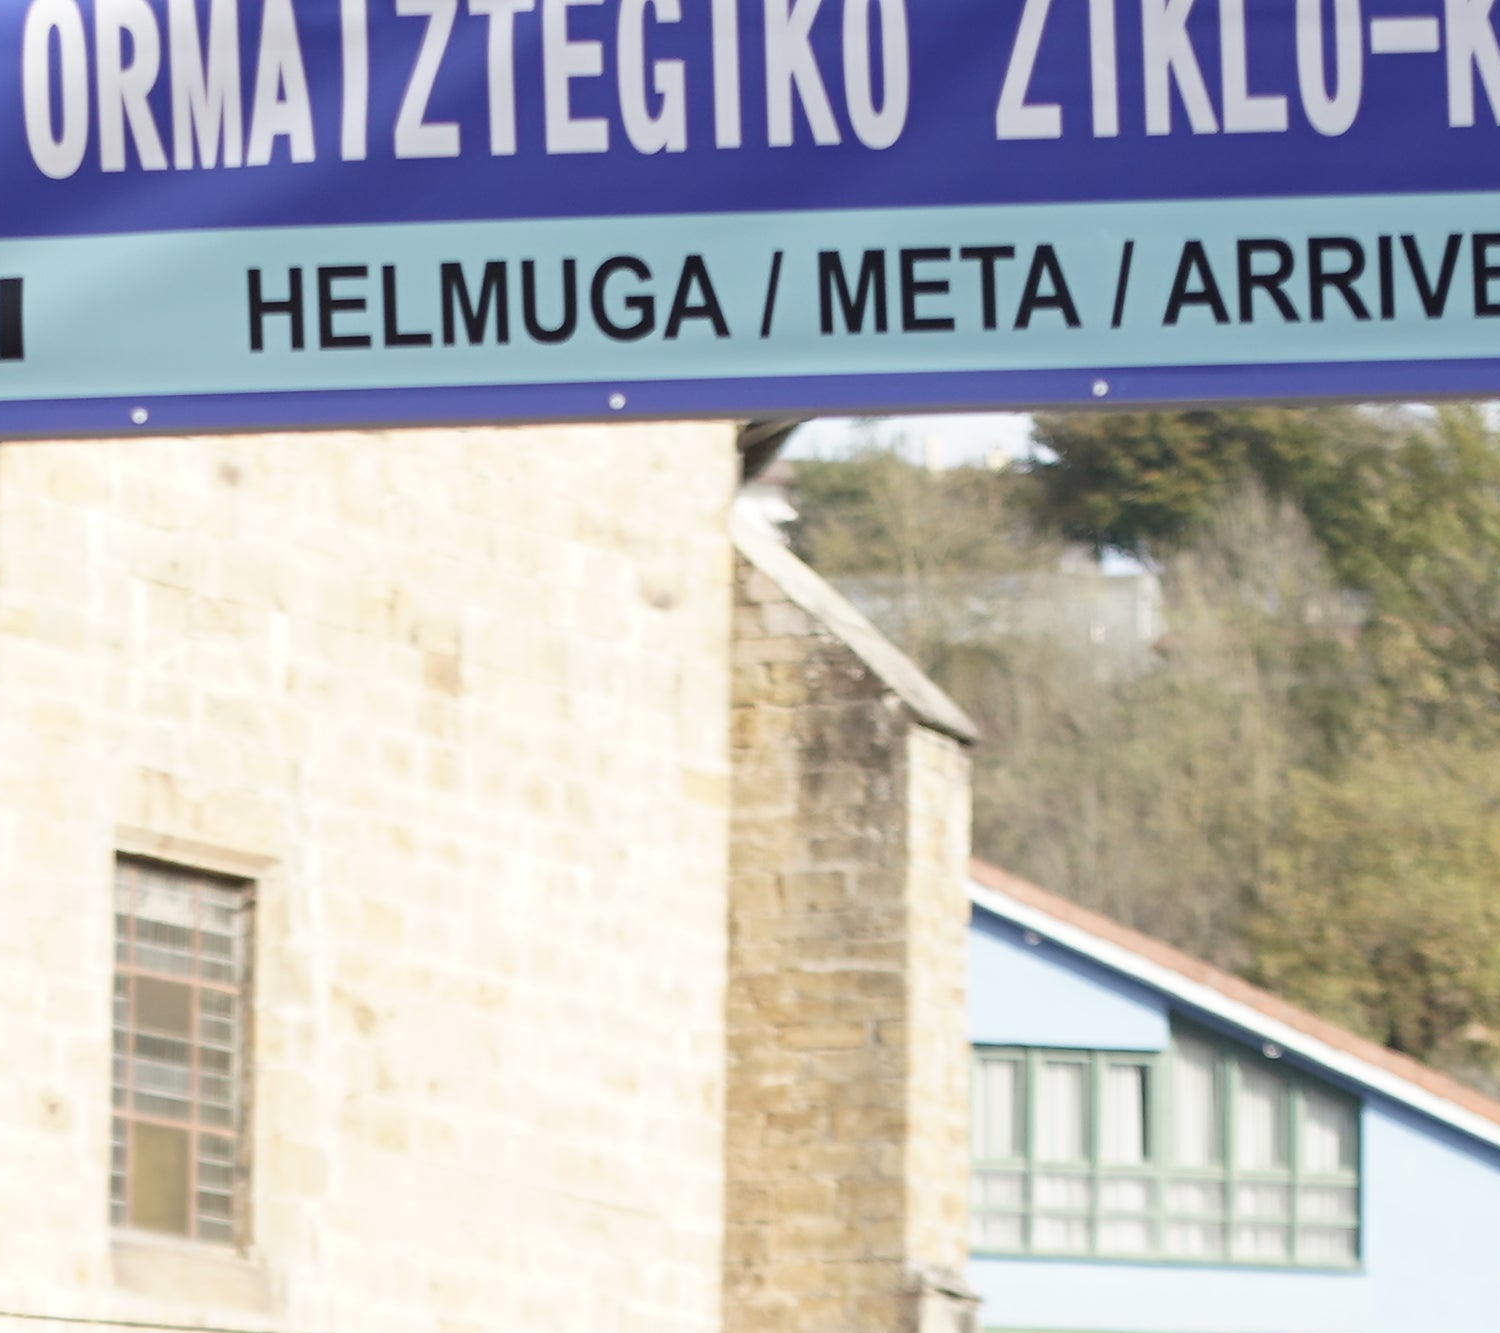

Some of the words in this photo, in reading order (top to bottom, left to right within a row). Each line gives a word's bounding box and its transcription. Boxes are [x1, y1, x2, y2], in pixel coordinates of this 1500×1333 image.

[23, 0, 910, 180] ORMAIZTEGIKO
[246, 253, 731, 353] HELMUGA
[760, 250, 784, 338] /
[817, 242, 1082, 335] META
[1110, 240, 1135, 329] /
